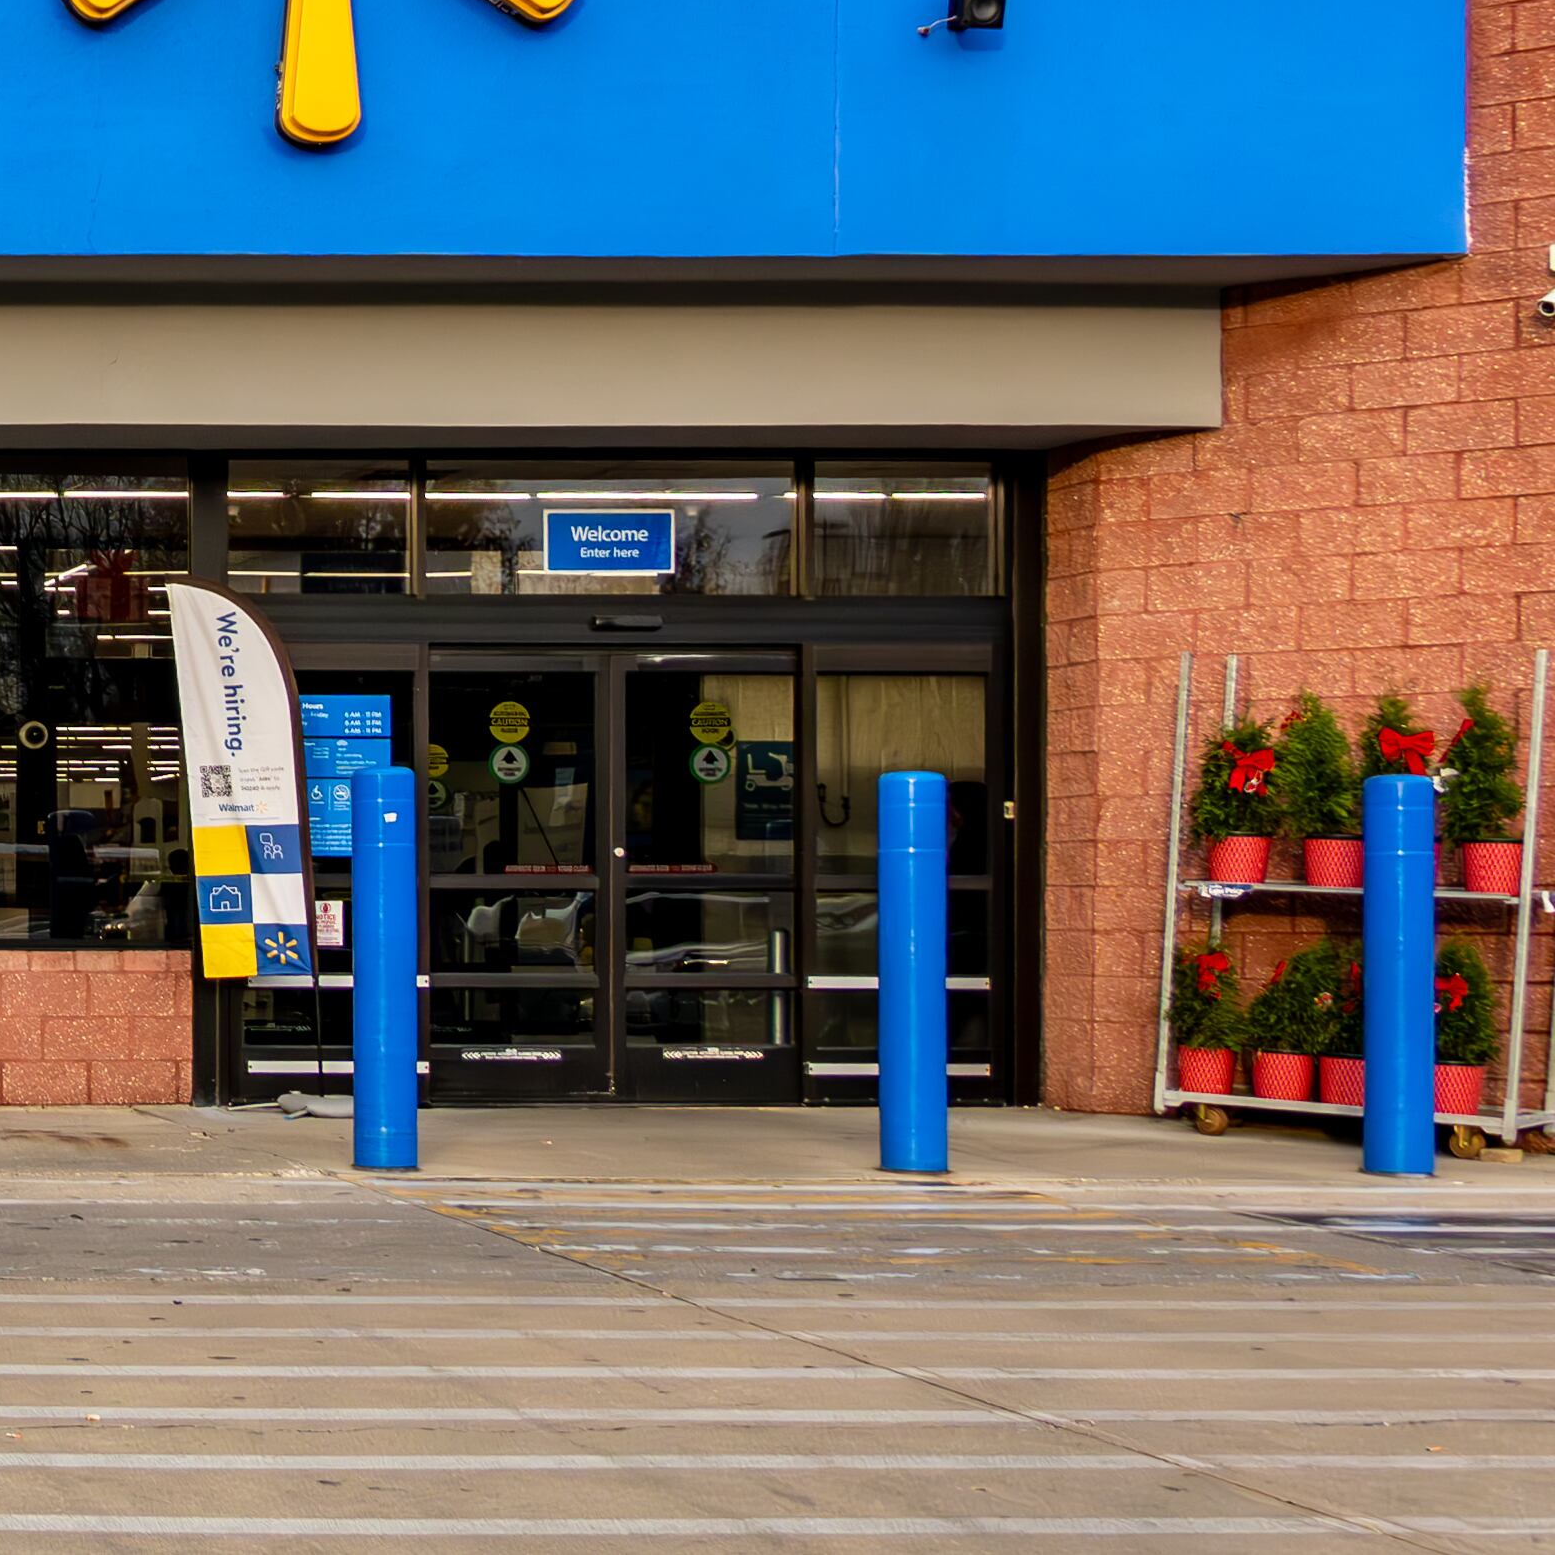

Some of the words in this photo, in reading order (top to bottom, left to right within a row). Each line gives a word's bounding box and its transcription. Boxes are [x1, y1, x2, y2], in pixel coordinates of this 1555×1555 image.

[570, 525, 649, 542] Welcome
[580, 547, 611, 558] Enter
[613, 547, 640, 558] here
[216, 611, 239, 678] We're
[223, 684, 247, 758] hiring.
[491, 717, 529, 726] CAUTION
[691, 717, 729, 726] CAUTION
[218, 802, 255, 813] Walmart
